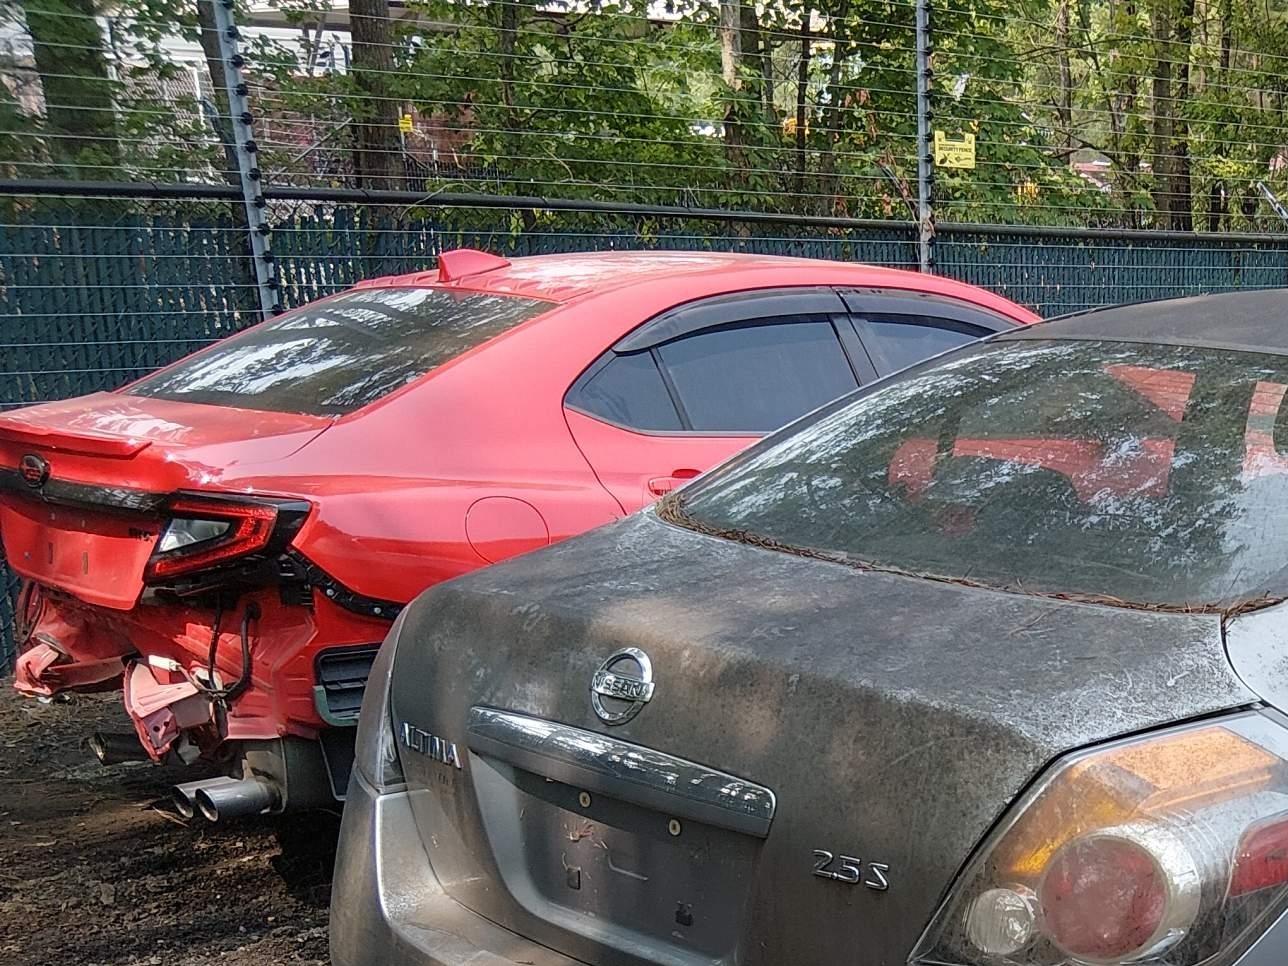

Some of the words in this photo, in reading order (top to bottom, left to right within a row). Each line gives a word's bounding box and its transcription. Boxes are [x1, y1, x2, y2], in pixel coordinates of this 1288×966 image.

[594, 672, 646, 699] NISSAN
[400, 721, 463, 769] ALTIMA
[864, 861, 890, 891] S
